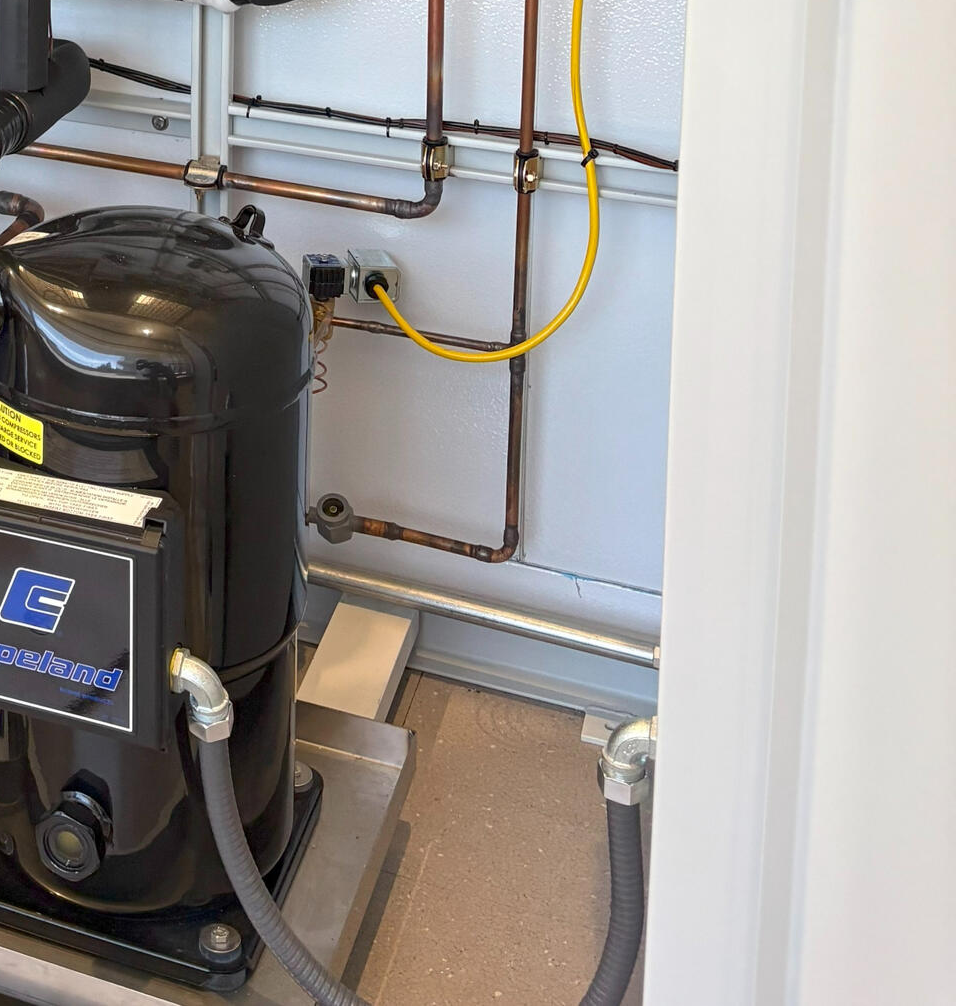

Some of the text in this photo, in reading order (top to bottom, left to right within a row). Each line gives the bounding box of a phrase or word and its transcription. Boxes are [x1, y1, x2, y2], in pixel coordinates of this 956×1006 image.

[1, 416, 41, 442] COMPRESSORS
[5, 438, 14, 448] OR
[14, 442, 42, 461] BLOCKED
[14, 433, 37, 450] SERVICE
